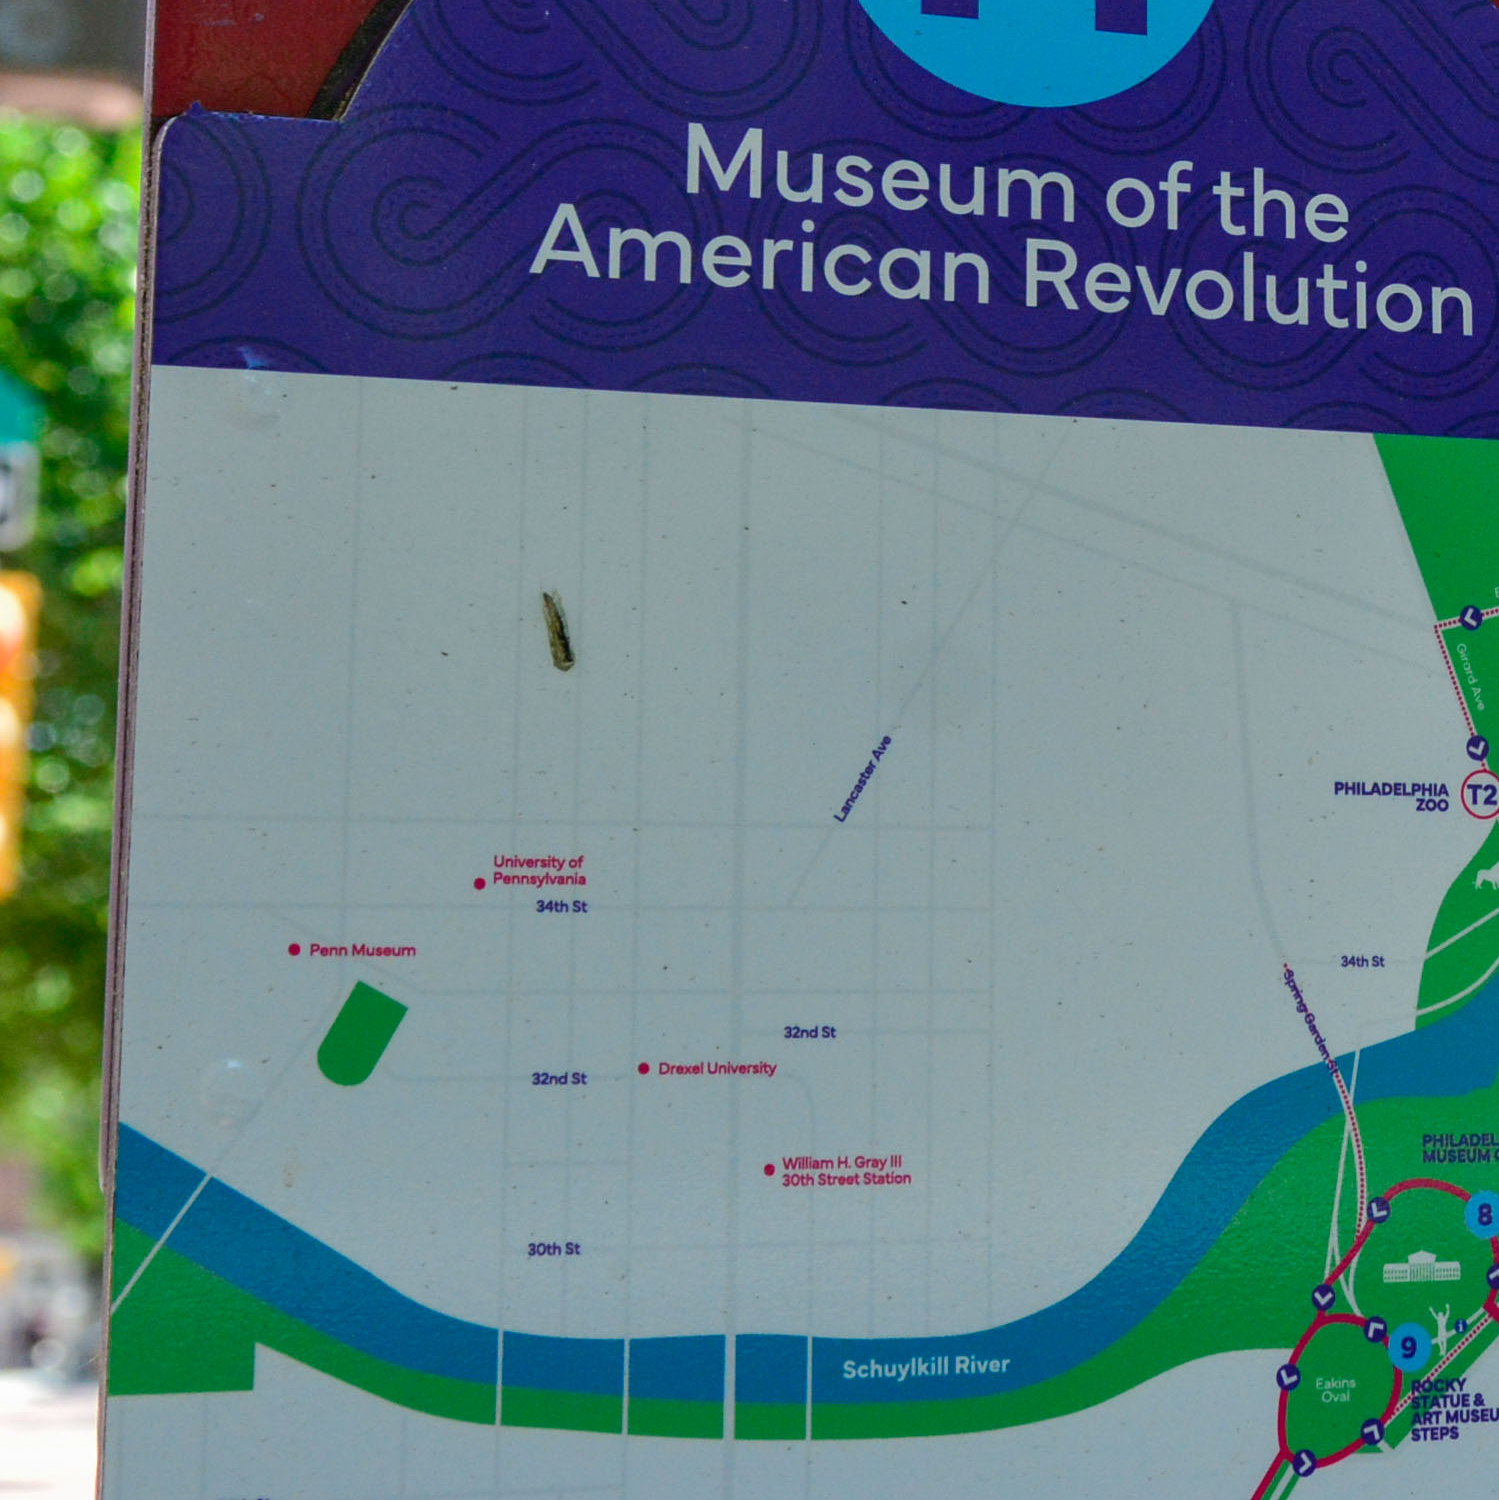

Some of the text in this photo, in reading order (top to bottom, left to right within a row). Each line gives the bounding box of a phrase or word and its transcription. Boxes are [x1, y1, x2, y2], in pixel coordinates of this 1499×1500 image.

[686, 123, 1350, 243] Museum of the
[530, 204, 1473, 337] American Revolution
[1456, 643, 1485, 711] Girard Ave
[833, 733, 893, 822] Lancaster Ave
[1335, 782, 1449, 797] PHILADELPHIA
[1467, 784, 1498, 805] T2
[1416, 799, 1449, 811] ZOO
[494, 855, 584, 871] University of
[493, 871, 586, 888] Pennsylvania
[536, 899, 587, 914] 34th St
[310, 943, 416, 957] Penn Museum
[1341, 956, 1384, 968] 34th St
[1283, 970, 1339, 1077] Spring Garden St
[784, 1025, 836, 1040] 32nd St
[658, 1060, 777, 1078] Drexel University
[531, 1071, 587, 1086] 32nd St
[1422, 1148, 1491, 1163] MUSEUM
[782, 1155, 902, 1174] William H. Gray III
[782, 1171, 911, 1186] 30th Street Station
[1478, 1204, 1493, 1224] 8
[528, 1242, 580, 1256] 30th St
[1401, 1337, 1416, 1358] 9
[843, 1356, 1010, 1381] Schuylkill River
[1316, 1377, 1356, 1389] Eakins
[1412, 1378, 1466, 1393] ROCKY
[1321, 1390, 1350, 1403] Oval
[1412, 1394, 1485, 1408] STATUE &
[1411, 1409, 1442, 1424] ART
[1411, 1426, 1459, 1440] STEPS
